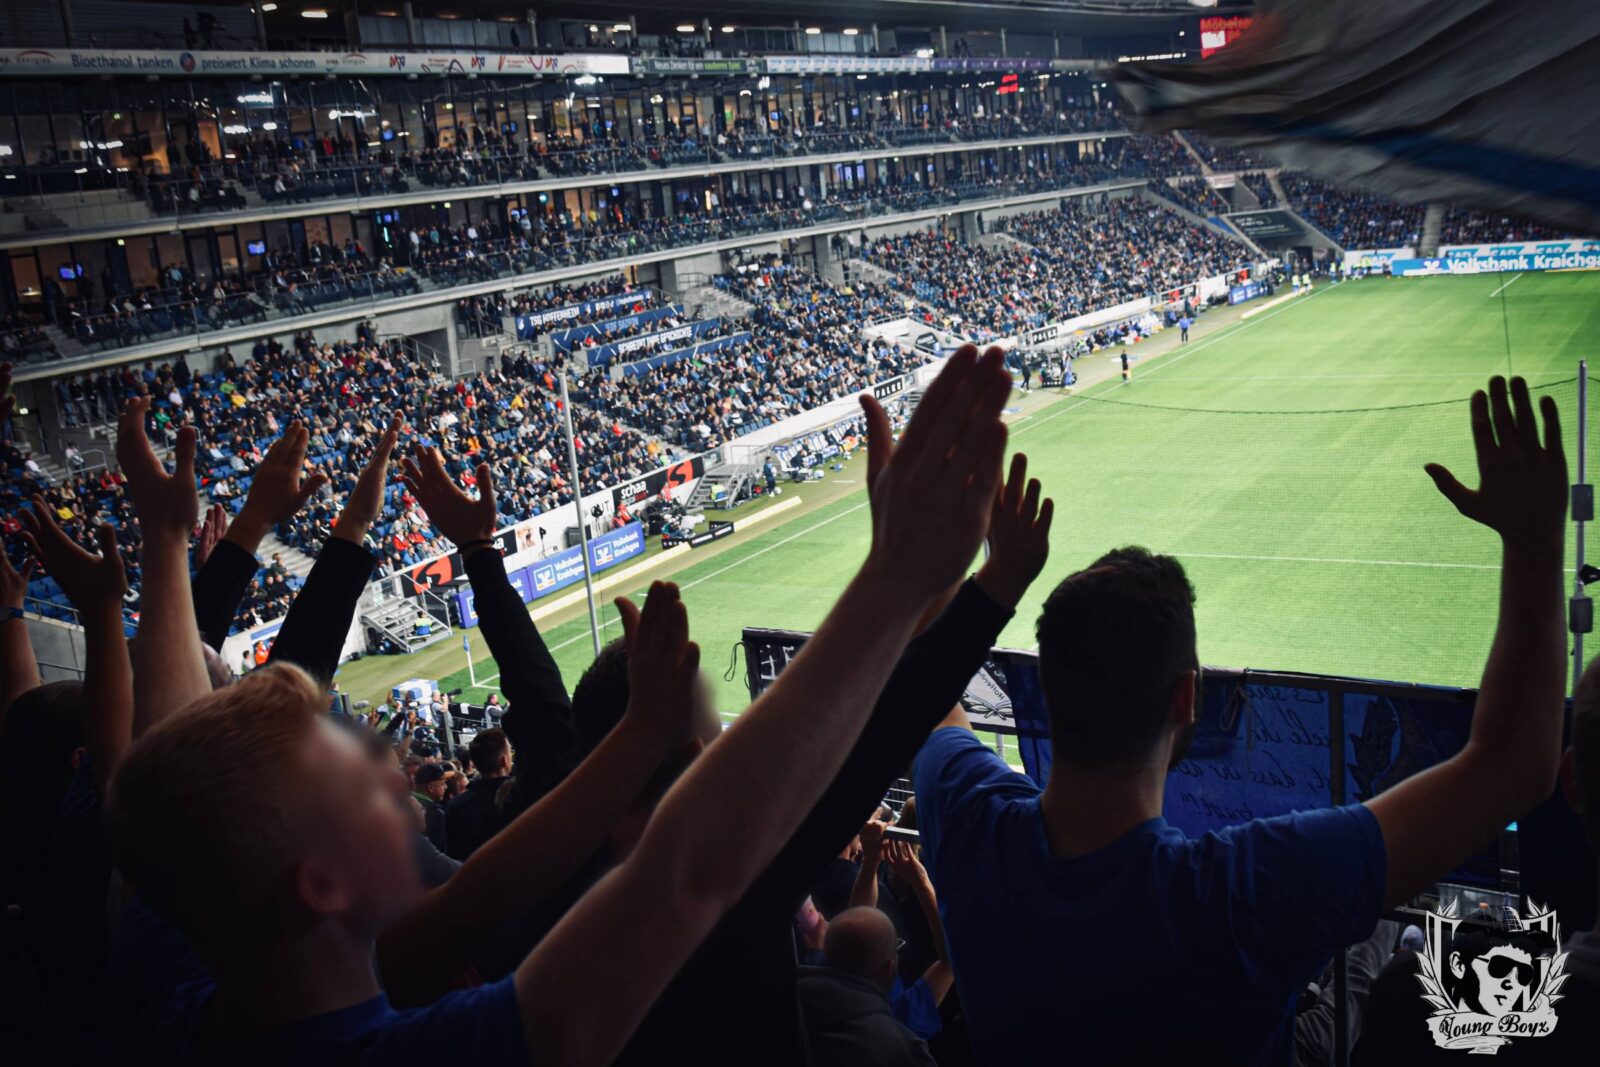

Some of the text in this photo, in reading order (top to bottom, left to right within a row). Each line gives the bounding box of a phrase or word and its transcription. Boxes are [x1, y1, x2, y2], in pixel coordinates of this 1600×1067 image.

[72, 53, 174, 69] Bioethanol tanken
[201, 57, 246, 71] preiswert
[250, 56, 276, 69] Klima
[279, 57, 316, 69] schonen
[1446, 252, 1600, 273] Volksbank Kraichg
[542, 306, 580, 323] HOFFENHEIM
